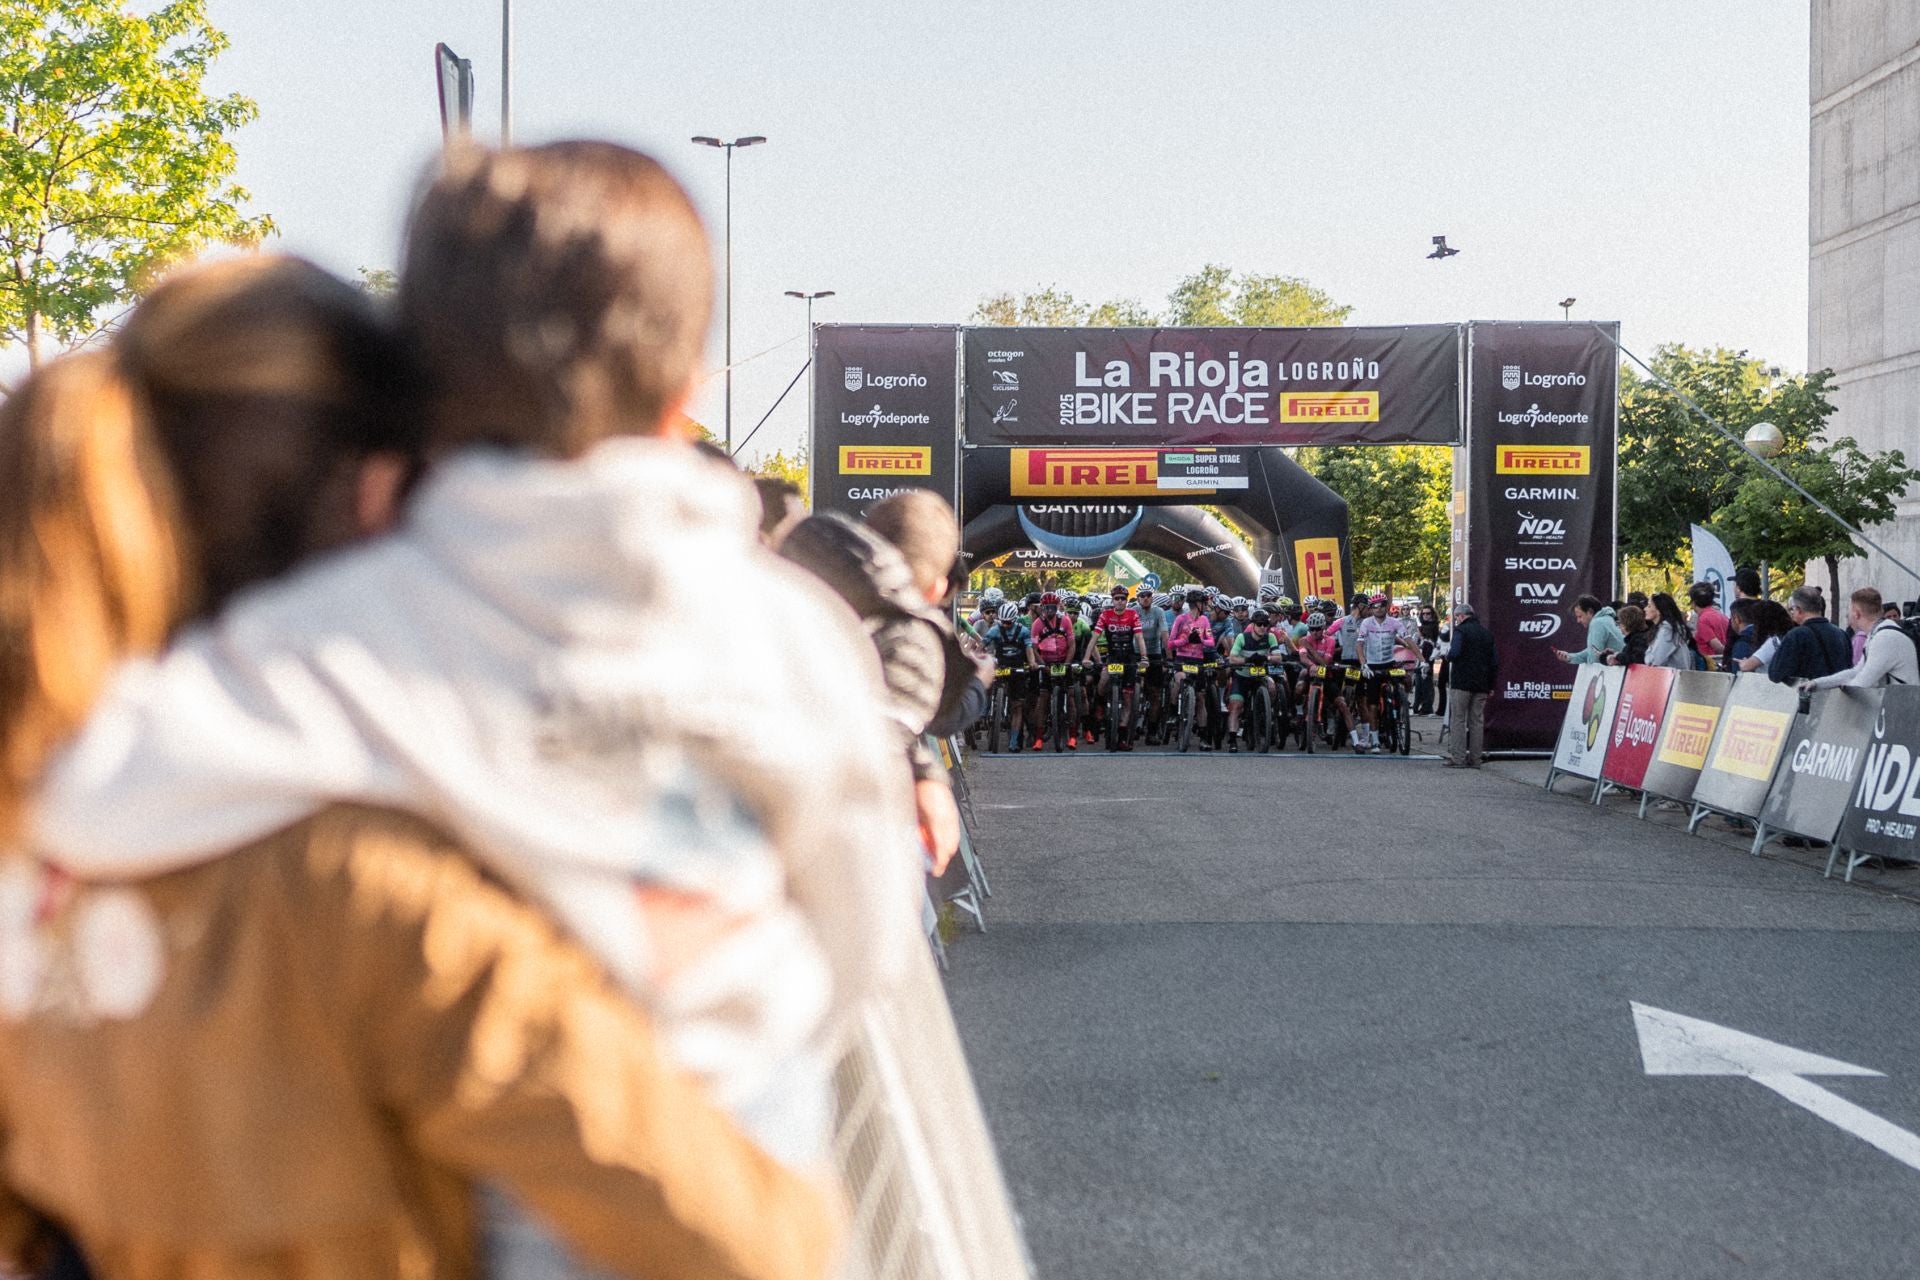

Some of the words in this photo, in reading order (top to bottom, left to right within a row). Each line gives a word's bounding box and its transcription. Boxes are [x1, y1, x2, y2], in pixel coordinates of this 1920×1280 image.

[988, 351, 1024, 361] octagon
[1075, 352, 1130, 387] La
[1150, 352, 1269, 393] Rioja
[1278, 358, 1379, 381] LOGROÑO
[867, 373, 927, 389] Logroño
[1525, 372, 1586, 388] Logroño
[1060, 394, 1074, 425] 2025
[1075, 393, 1157, 424] BIKE
[1168, 393, 1270, 424] RACE
[1289, 398, 1370, 416] PIRELLI
[847, 452, 923, 468] PIRELLI
[1195, 455, 1218, 463] SUPER
[1219, 455, 1241, 463] STAGE
[1504, 452, 1581, 468] PIRELLI
[1186, 465, 1219, 474] LOGROÑO
[1517, 518, 1566, 534] NDL
[1186, 543, 1232, 560] garmin.com
[1040, 560, 1083, 568] ARAGÓN
[1507, 681, 1520, 690] La
[1523, 681, 1550, 691] Rioja
[1667, 715, 1713, 758] PIRELLI
[1724, 720, 1779, 766] PIRELLI
